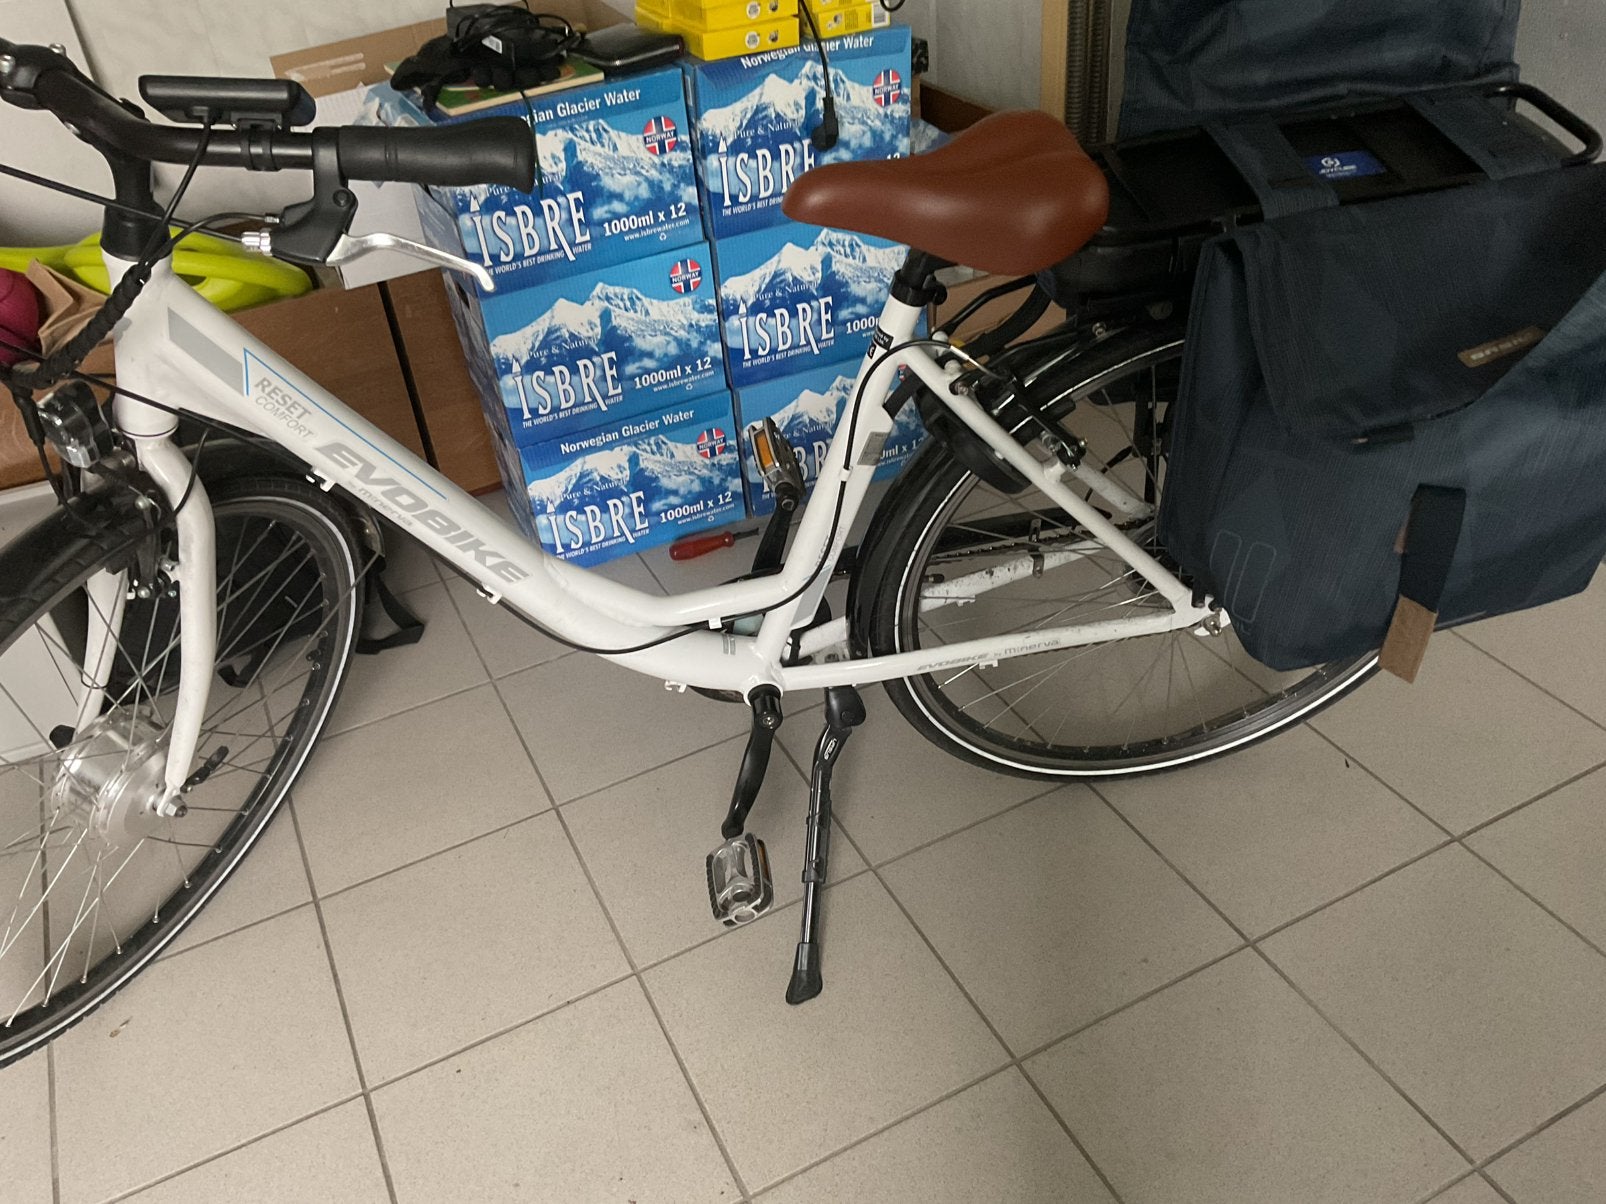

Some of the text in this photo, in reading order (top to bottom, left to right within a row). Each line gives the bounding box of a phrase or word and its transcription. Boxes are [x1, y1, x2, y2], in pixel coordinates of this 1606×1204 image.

[843, 36, 874, 49] Water
[874, 84, 899, 95] NORWAY
[556, 89, 641, 117] Glacier Water
[646, 131, 675, 143] NORWAY
[603, 202, 687, 237] 1000ml x 12
[624, 218, 690, 241] www.isbrewater.com
[495, 261, 522, 275] WORLD'S
[523, 257, 536, 268] BEST
[537, 250, 565, 264] DRINKING
[572, 243, 592, 255] WATER
[672, 271, 700, 284] NORWAY
[846, 316, 879, 334] 1000
[634, 356, 712, 389] 1000ml x 12
[254, 377, 312, 420] RESET
[254, 395, 313, 439] COMFORT
[523, 420, 532, 428] THE
[533, 413, 558, 426] WORLD'S
[559, 409, 571, 419] BEST
[572, 403, 598, 415] DRINKING
[560, 409, 695, 455] Norwegian Glacier Water
[698, 438, 724, 450] NORWAY
[315, 442, 531, 583] EVOBIKE
[660, 491, 732, 523] 1000ml x 12
[566, 547, 589, 559] WORLD'S
[589, 543, 601, 552] BEST
[1004, 639, 1061, 654] minerva
